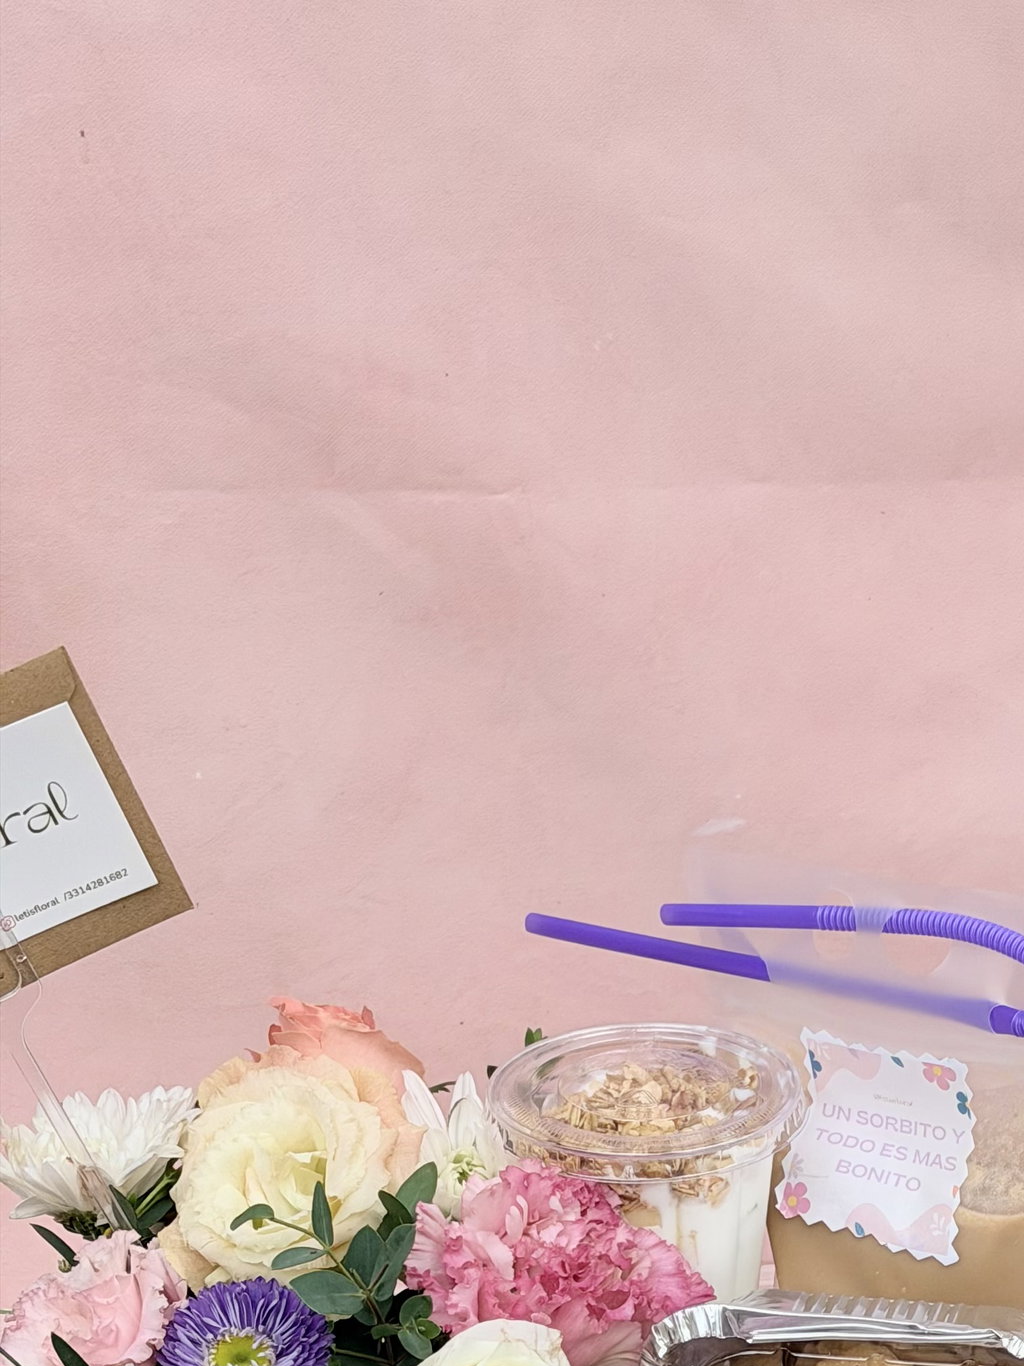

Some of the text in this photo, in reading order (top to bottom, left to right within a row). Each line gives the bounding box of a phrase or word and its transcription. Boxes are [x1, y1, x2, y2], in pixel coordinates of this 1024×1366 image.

[14, 868, 129, 922] letisfloral /3314281682
[822, 1102, 966, 1145] UN SORBITO Y
[815, 1127, 958, 1172] TODO ES MAS
[834, 1158, 922, 1193] BONITO
